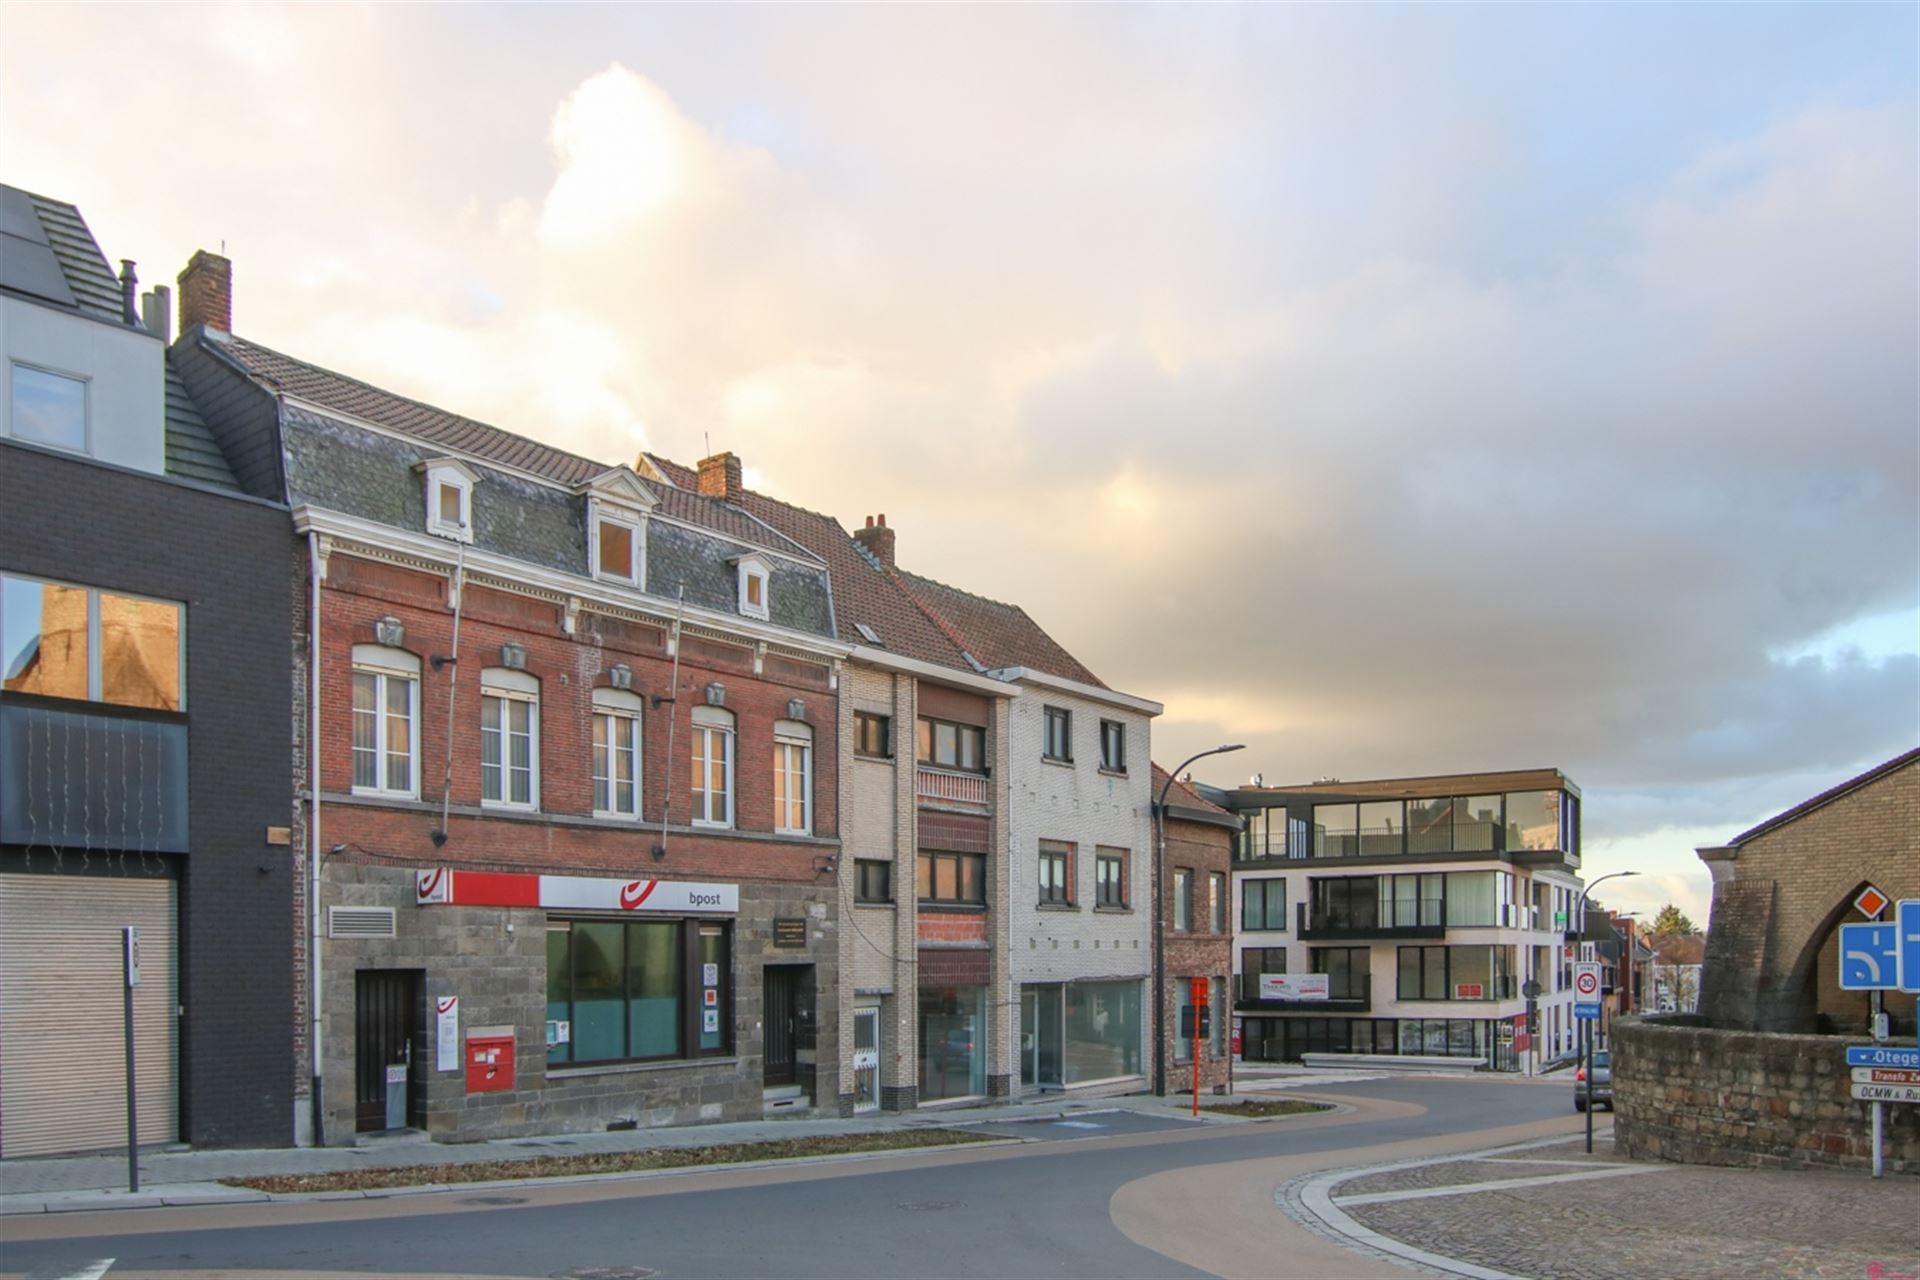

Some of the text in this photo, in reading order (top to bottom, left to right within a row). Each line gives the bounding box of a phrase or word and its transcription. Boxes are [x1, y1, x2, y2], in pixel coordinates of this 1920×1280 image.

[689, 891, 720, 907] bpost
[1582, 978, 1593, 988] 30
[1874, 1070, 1906, 1081] Transfo
[1861, 1086, 1893, 1098] OCMW
